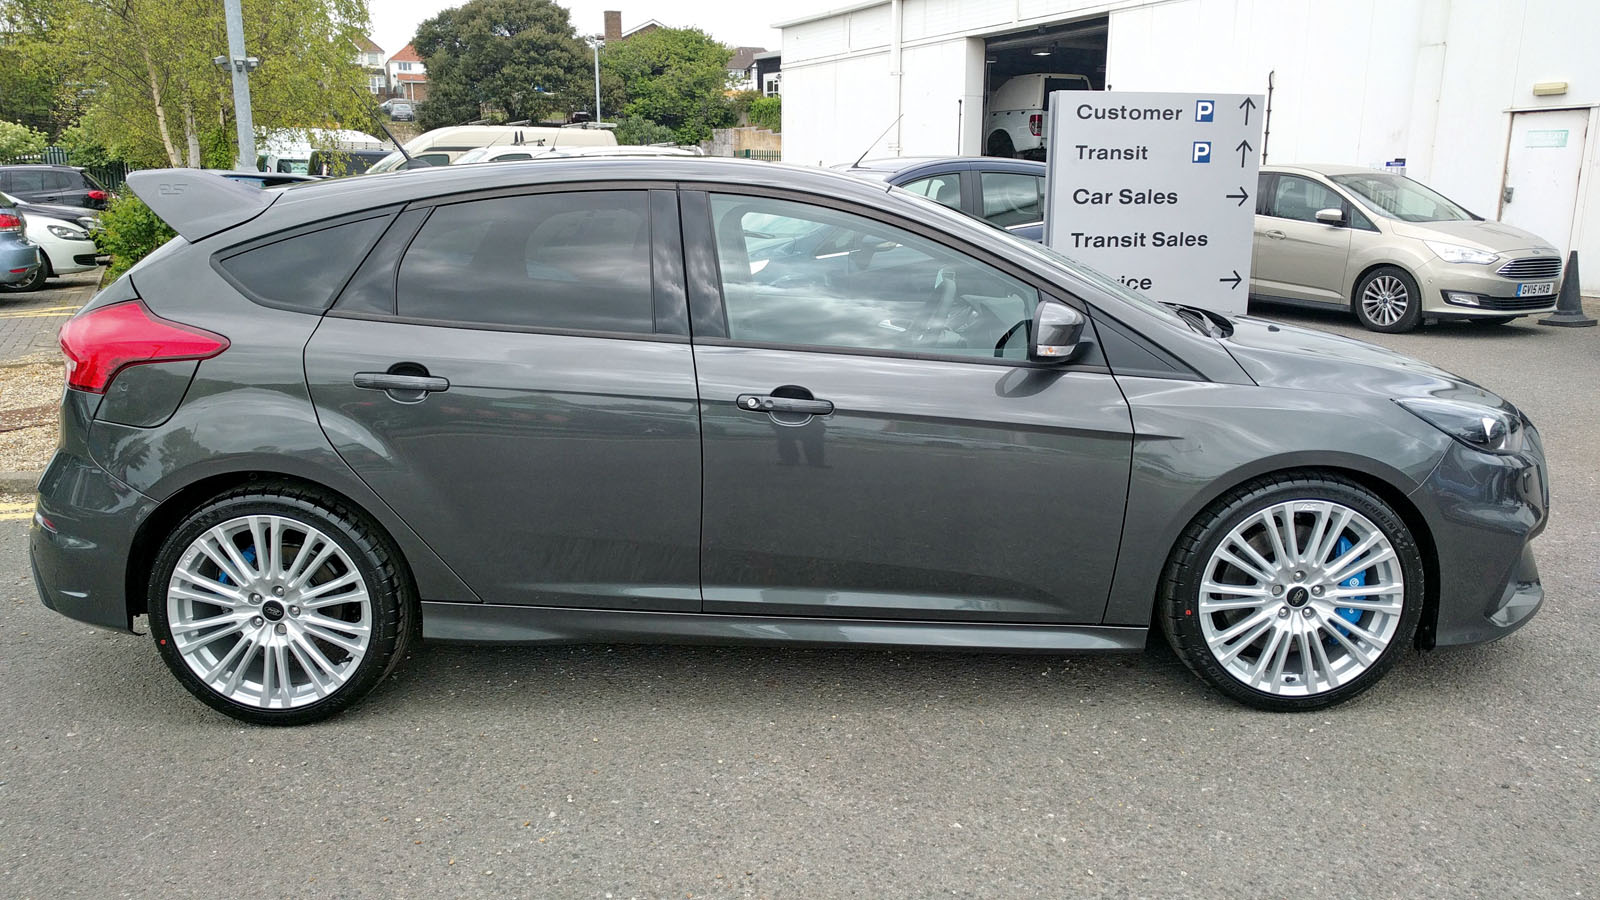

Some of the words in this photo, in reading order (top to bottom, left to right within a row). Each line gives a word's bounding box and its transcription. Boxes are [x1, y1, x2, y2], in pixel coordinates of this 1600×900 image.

[1076, 104, 1183, 121] Customer
[1196, 101, 1213, 121] P
[1075, 145, 1149, 161] Transit
[1193, 143, 1210, 162] P
[1072, 188, 1113, 205] Car
[1118, 188, 1178, 205] Sales
[1070, 232, 1146, 249] Transit
[1151, 231, 1208, 248] Sales
